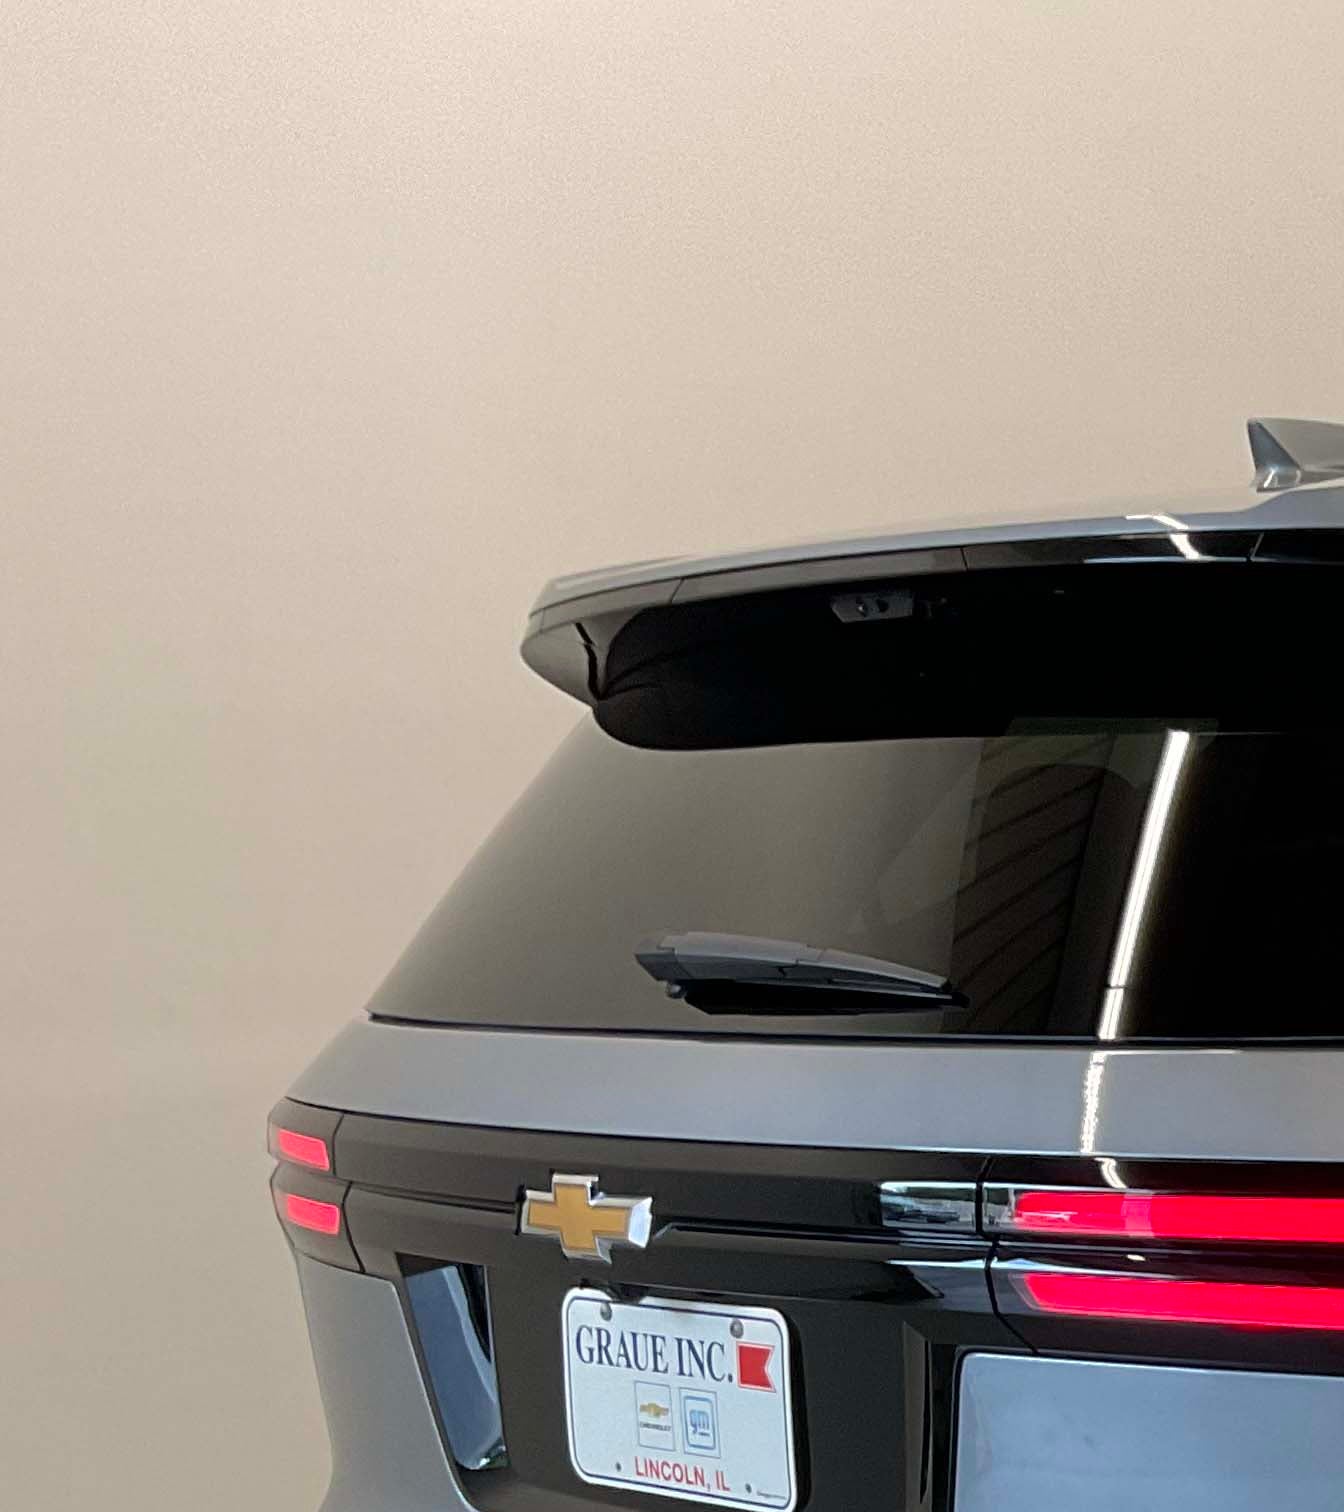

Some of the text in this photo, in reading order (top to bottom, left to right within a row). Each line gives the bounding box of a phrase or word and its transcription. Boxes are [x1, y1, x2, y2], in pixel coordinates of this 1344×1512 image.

[575, 1325, 734, 1383] GRAUE INC.
[634, 1456, 731, 1491] LINCOLN, IL
